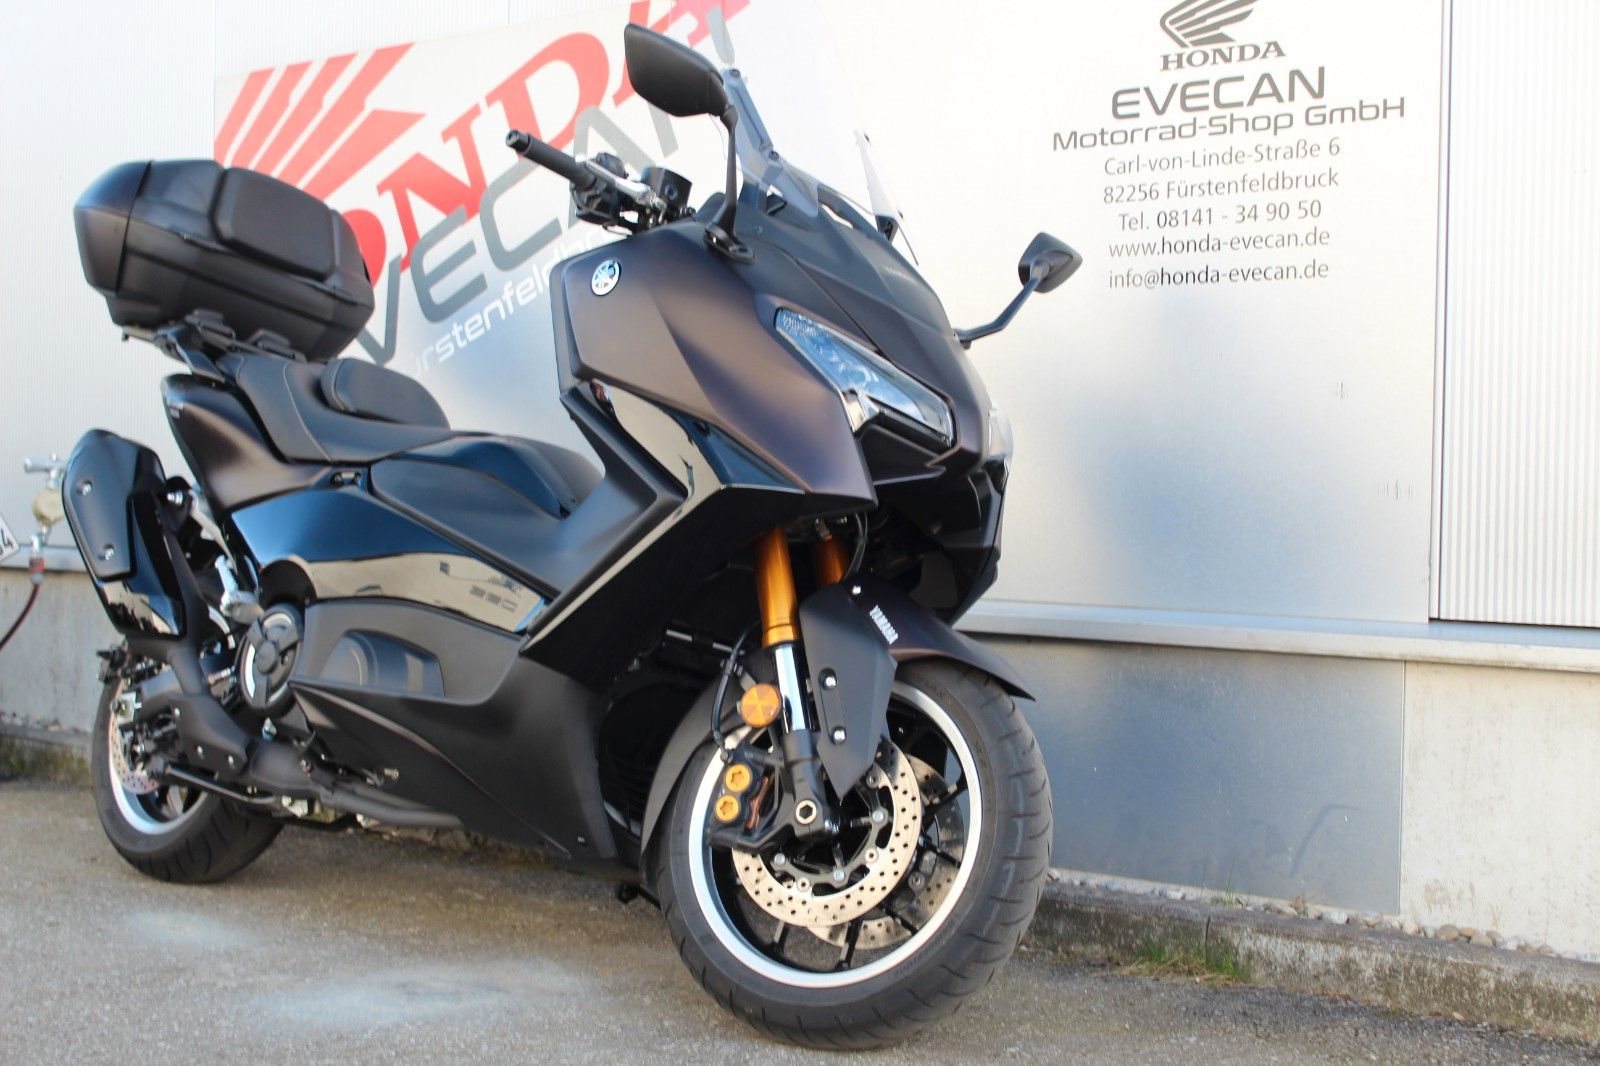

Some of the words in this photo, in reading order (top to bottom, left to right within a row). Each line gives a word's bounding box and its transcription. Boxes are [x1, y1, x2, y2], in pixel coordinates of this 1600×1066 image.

[1159, 40, 1287, 72] HONDA
[1111, 66, 1326, 120] EVECAN
[1053, 112, 1294, 151] Motorrad-Shop
[1305, 96, 1405, 126] GmbH
[1104, 138, 1321, 175] Carl-von-Linde-Straße
[1328, 136, 1341, 156] 6
[1103, 182, 1160, 204] 82256
[1166, 167, 1340, 200] Fürstenfeldbruck
[1118, 210, 1150, 232] Tel.
[1156, 207, 1213, 229] 08141
[1235, 203, 1259, 224] 34
[1266, 201, 1290, 222] 90
[1298, 199, 1322, 219] 50
[1108, 226, 1331, 257] www.honda-evecan.de
[1108, 258, 1330, 289] info@honda-evecan.de
